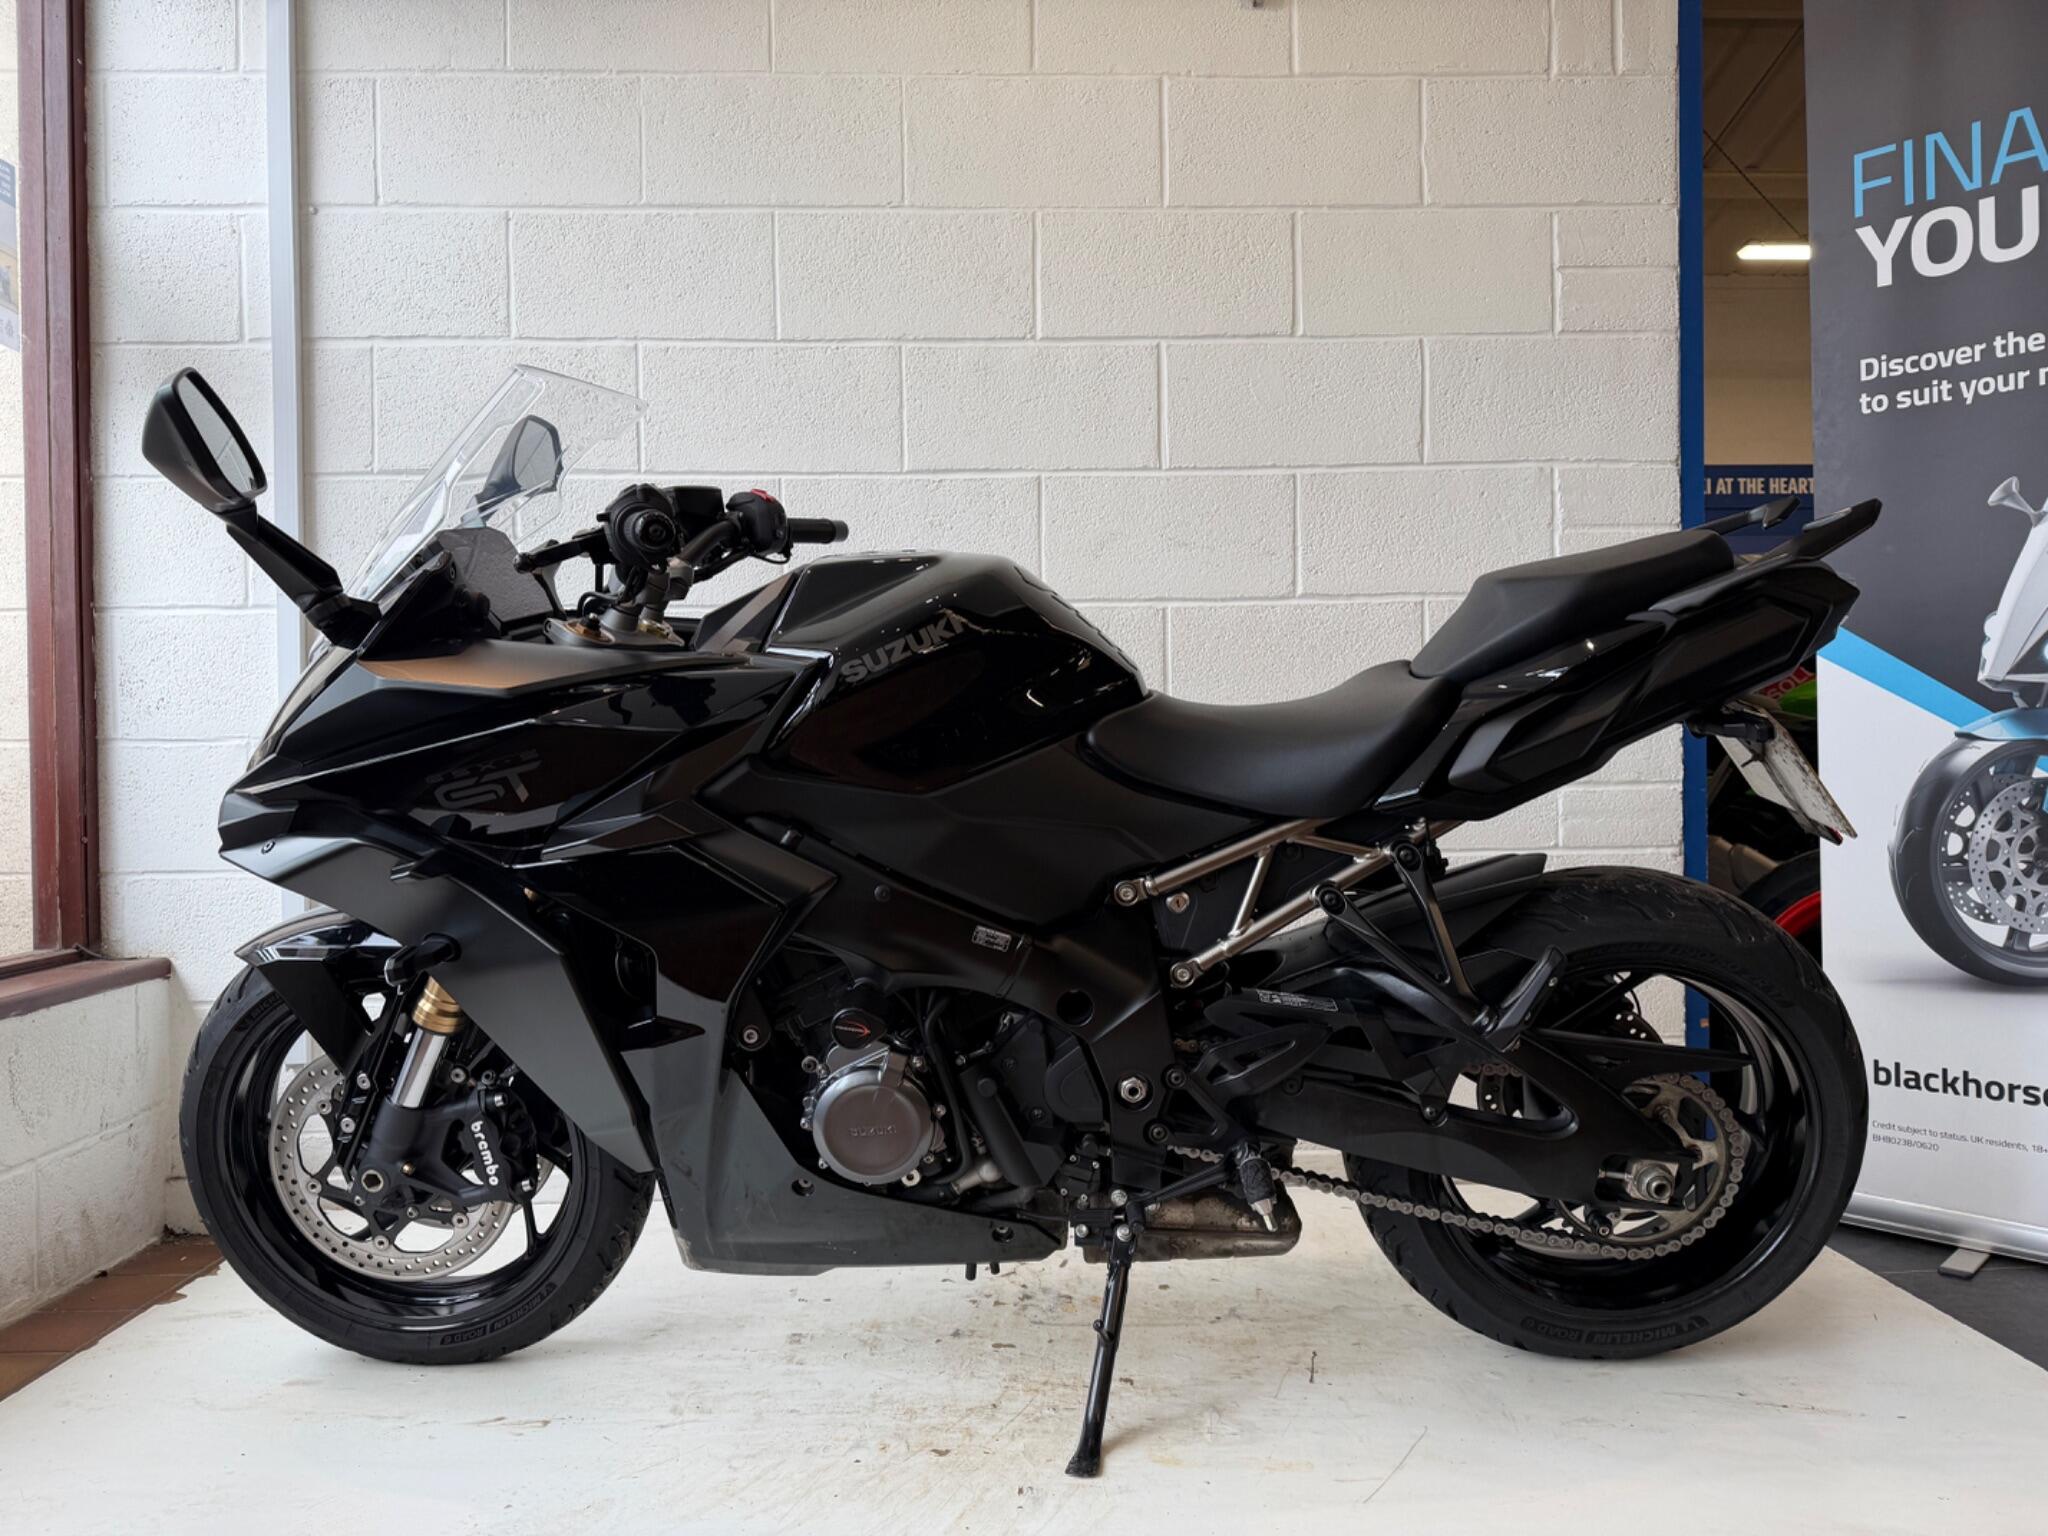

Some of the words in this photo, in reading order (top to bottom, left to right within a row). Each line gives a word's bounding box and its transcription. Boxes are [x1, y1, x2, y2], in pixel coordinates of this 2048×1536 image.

[1854, 107, 2048, 218] FINA
[1855, 184, 2040, 288] YOU
[1859, 343, 1987, 382] Discover
[1993, 331, 2046, 359] the
[1858, 393, 1889, 415] to
[1896, 380, 1953, 409] suit
[1960, 370, 2031, 405] your
[1716, 478, 1733, 494] AT
[1738, 478, 1765, 494] THE
[841, 614, 964, 683] SUZUKI
[471, 1120, 499, 1186] brembo
[1873, 1119, 1896, 1130] Credit
[1897, 1126, 1927, 1136] subject
[1929, 1128, 1938, 1137] to
[1970, 1134, 1985, 1144] UK
[1537, 1321, 1577, 1342] ROAD
[1593, 1325, 1677, 1344] MICHELIN
